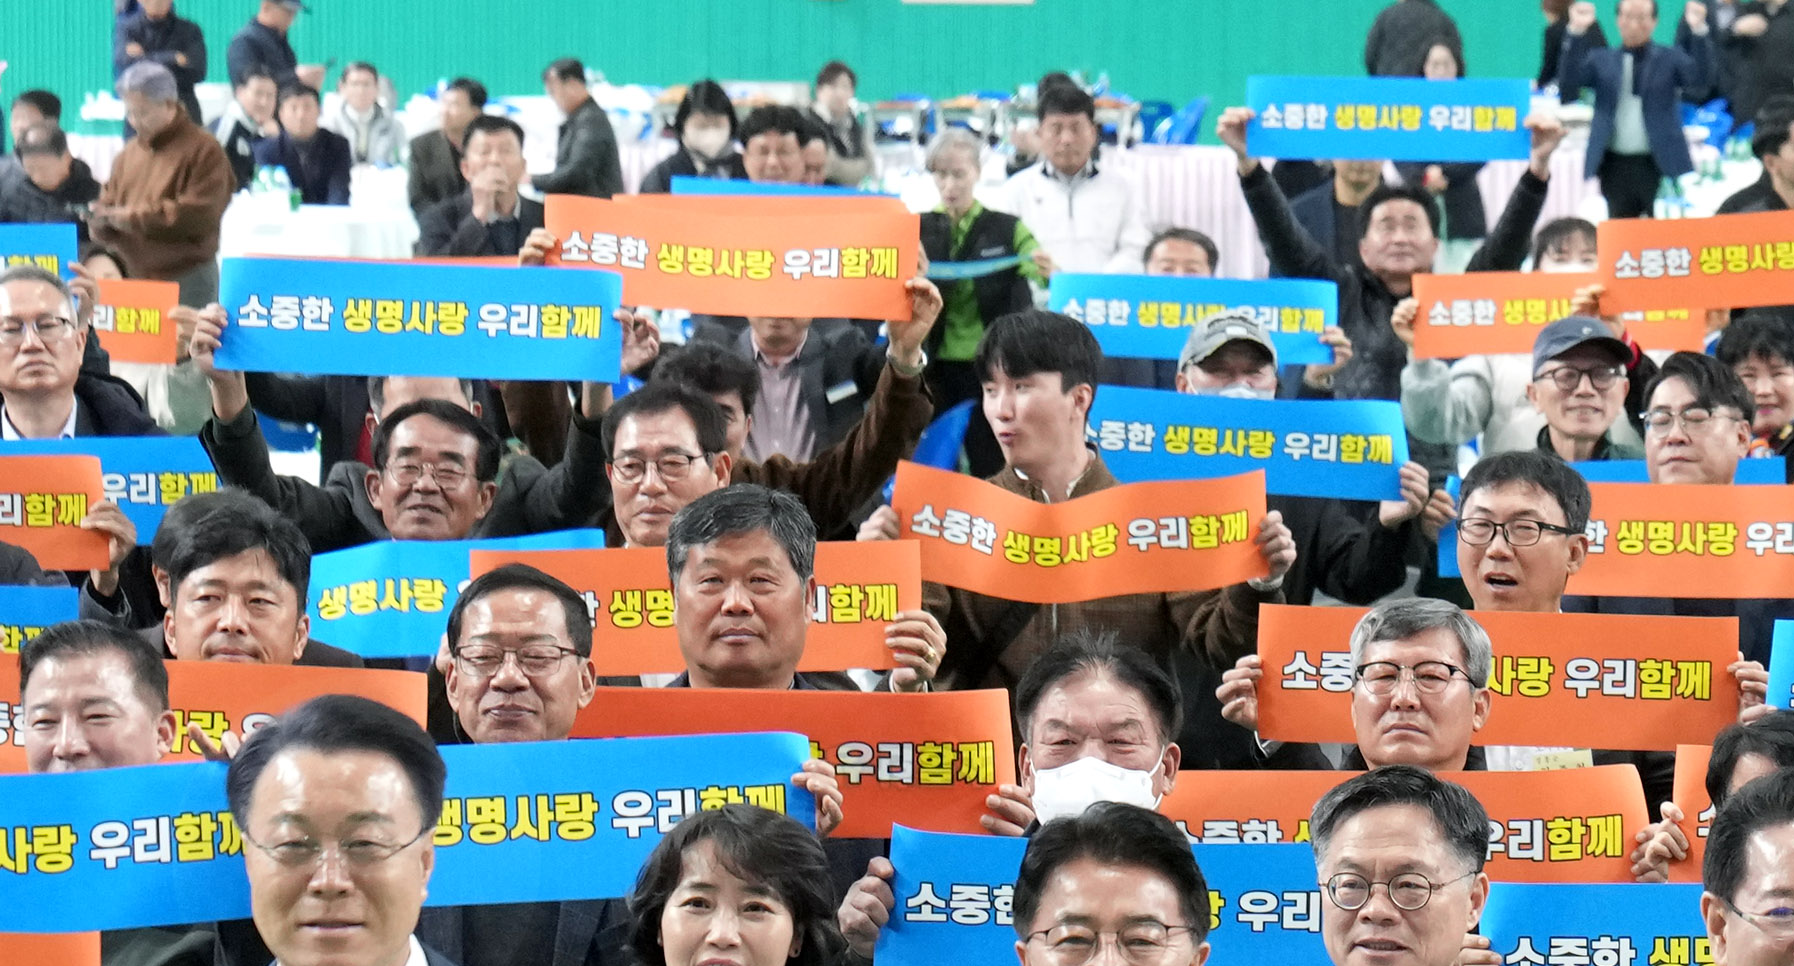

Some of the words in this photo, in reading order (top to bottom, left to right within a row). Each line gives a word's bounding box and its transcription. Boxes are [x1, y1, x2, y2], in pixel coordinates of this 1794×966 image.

[1261, 102, 1329, 130] 소중한
[1333, 103, 1424, 132] 생명사랑
[1428, 104, 1518, 133] 우리함께
[562, 229, 651, 268] 소중한
[656, 242, 776, 281] 생명사랑
[781, 247, 898, 281] 우리함께
[1614, 246, 1692, 279] 소중한
[93, 304, 161, 335] 리함께
[237, 294, 334, 332] 소중한
[342, 298, 470, 337] 생명사랑
[477, 303, 601, 340] 우리함께
[1428, 297, 1499, 327] 소중한
[1502, 300, 1571, 326] 생명사
[1163, 425, 1276, 459] 생명사랑
[1283, 432, 1394, 465] 우리함께
[910, 503, 999, 556] 소중한
[1003, 523, 1119, 567] 생명사랑
[1127, 509, 1248, 551] 우리함께
[1616, 520, 1739, 556] 생명사랑
[317, 577, 448, 621] 생명사랑
[609, 589, 674, 628] 생명
[813, 584, 898, 623] 함께
[1282, 651, 1352, 694] 소중
[1490, 657, 1554, 697] 사랑
[1564, 658, 1711, 699] 우리함께
[836, 740, 995, 786] 우리함께
[1238, 889, 1320, 934] 우리
